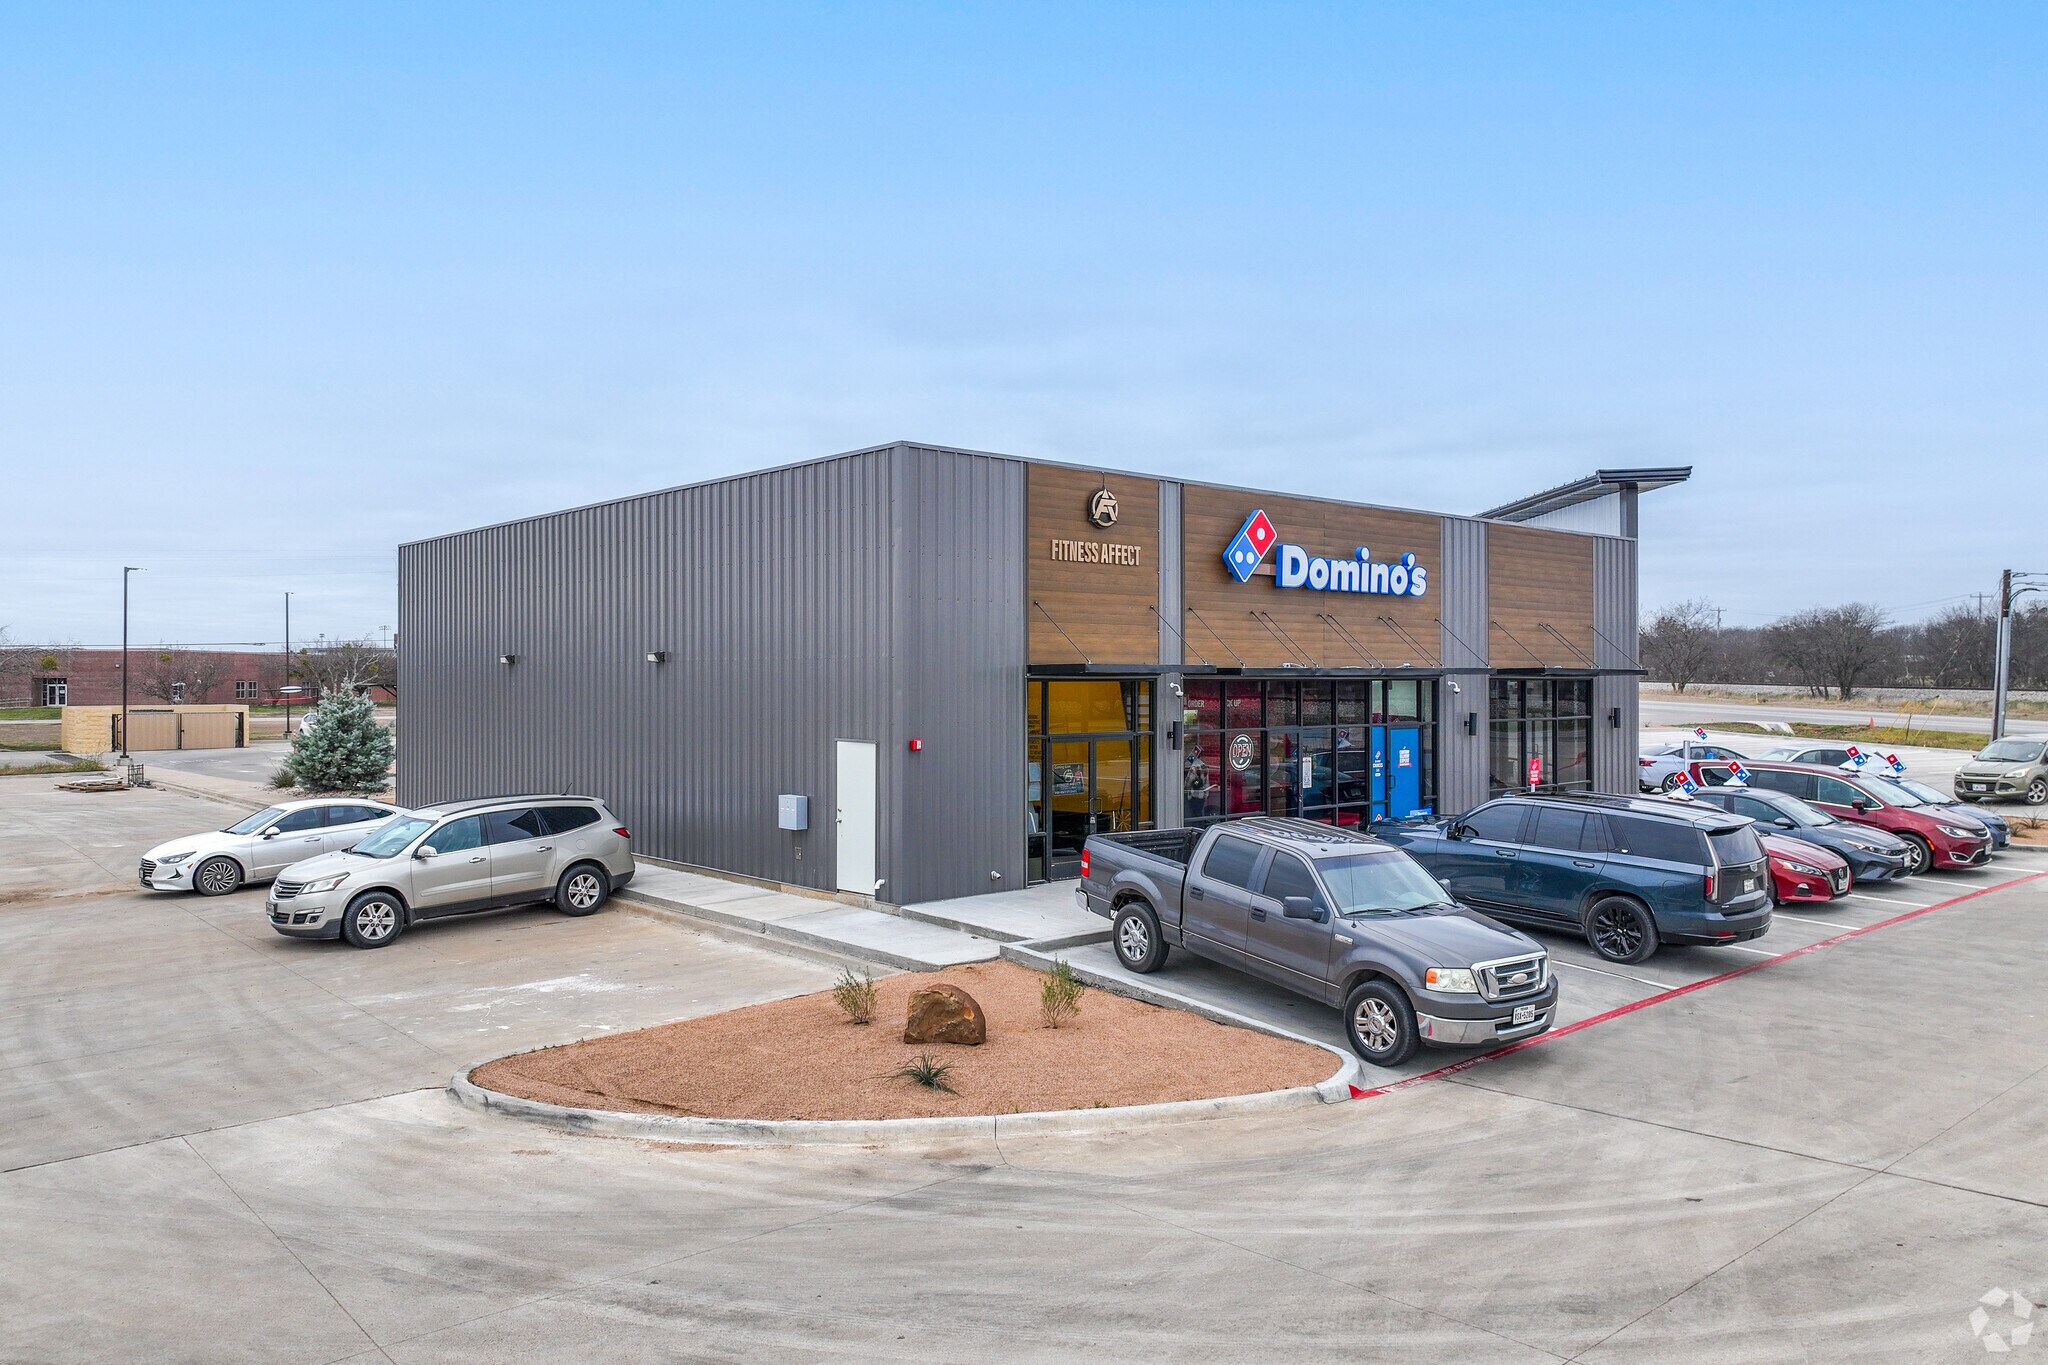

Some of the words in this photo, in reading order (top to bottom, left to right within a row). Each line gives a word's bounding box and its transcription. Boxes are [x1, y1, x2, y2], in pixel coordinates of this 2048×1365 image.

[1051, 539, 1099, 563] FITNESS
[1100, 543, 1141, 566] AFFECT
[1278, 544, 1427, 597] Domino's
[1232, 743, 1252, 758] OPEN
